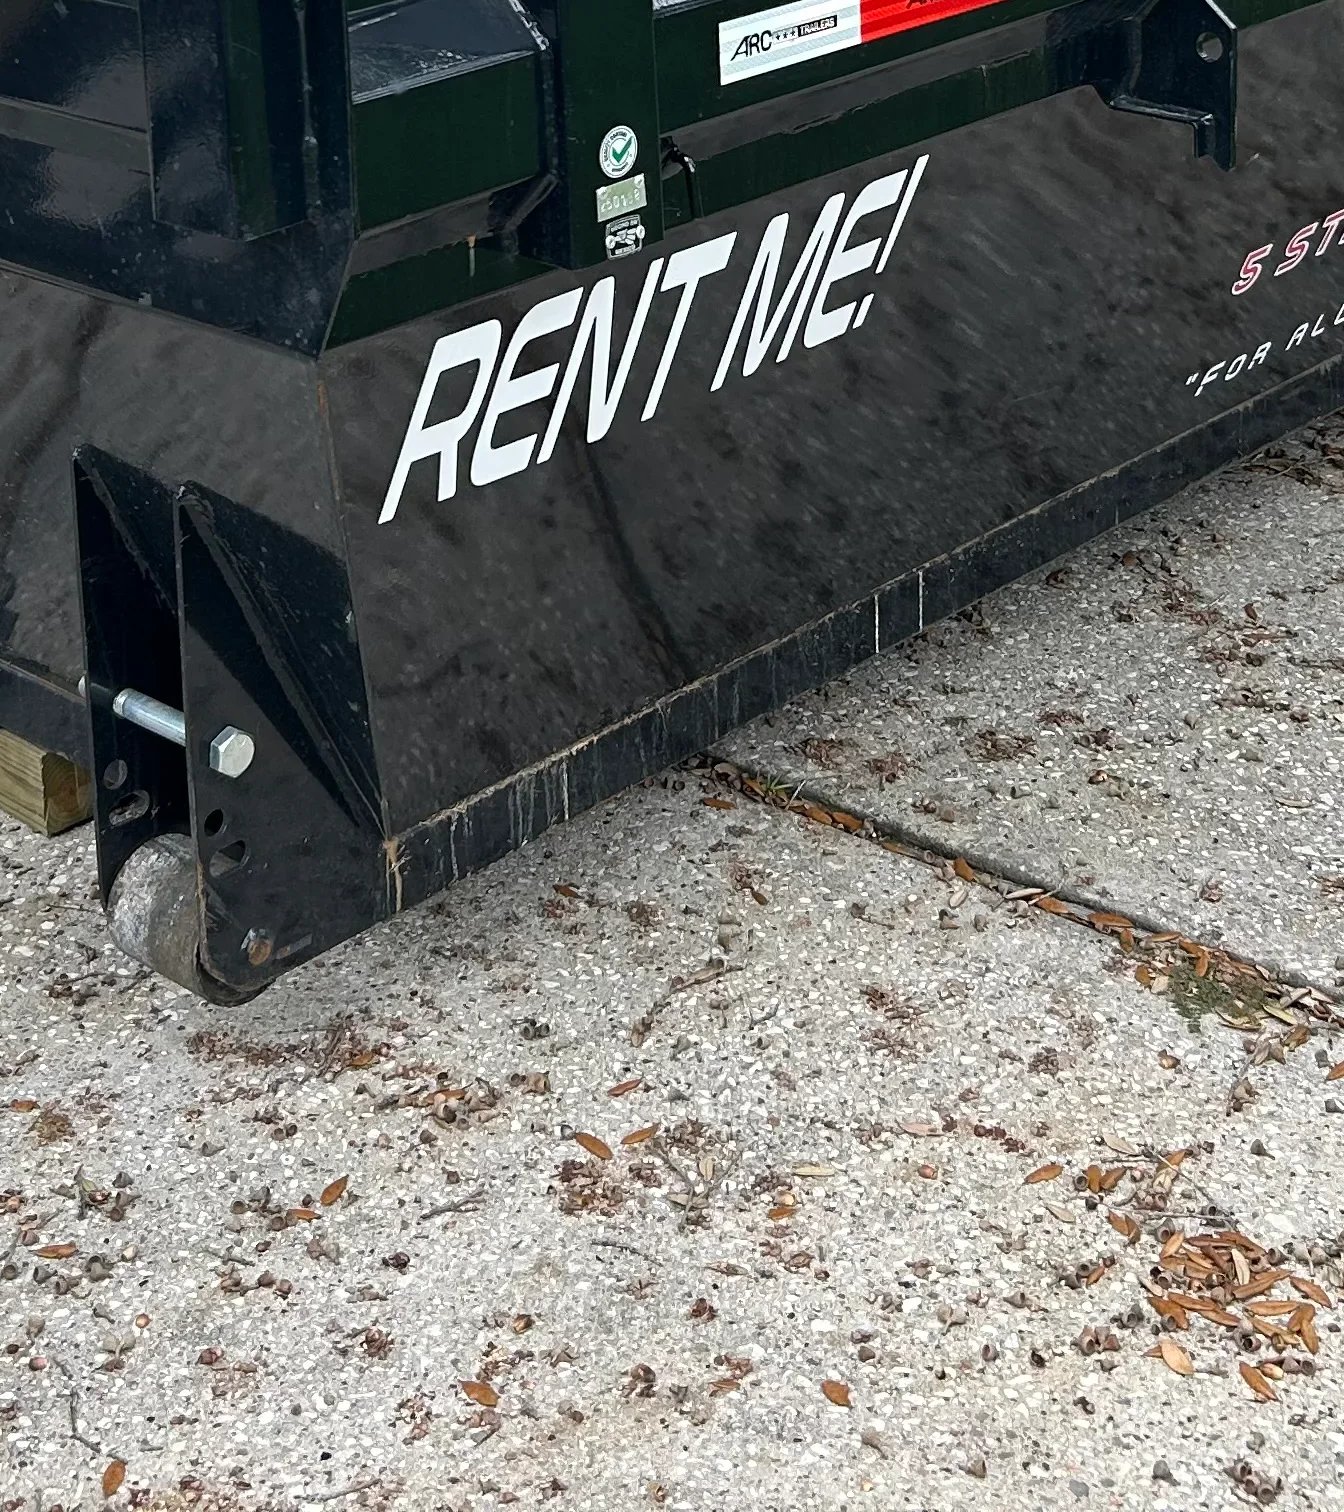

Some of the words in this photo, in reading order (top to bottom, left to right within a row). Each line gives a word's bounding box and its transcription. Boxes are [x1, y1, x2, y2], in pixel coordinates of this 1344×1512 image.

[730, 29, 773, 62] ARC
[799, 16, 836, 37] TRAILERS
[1231, 243, 1274, 296] 5
[378, 231, 739, 525] RENT
[710, 153, 931, 392] ME!
